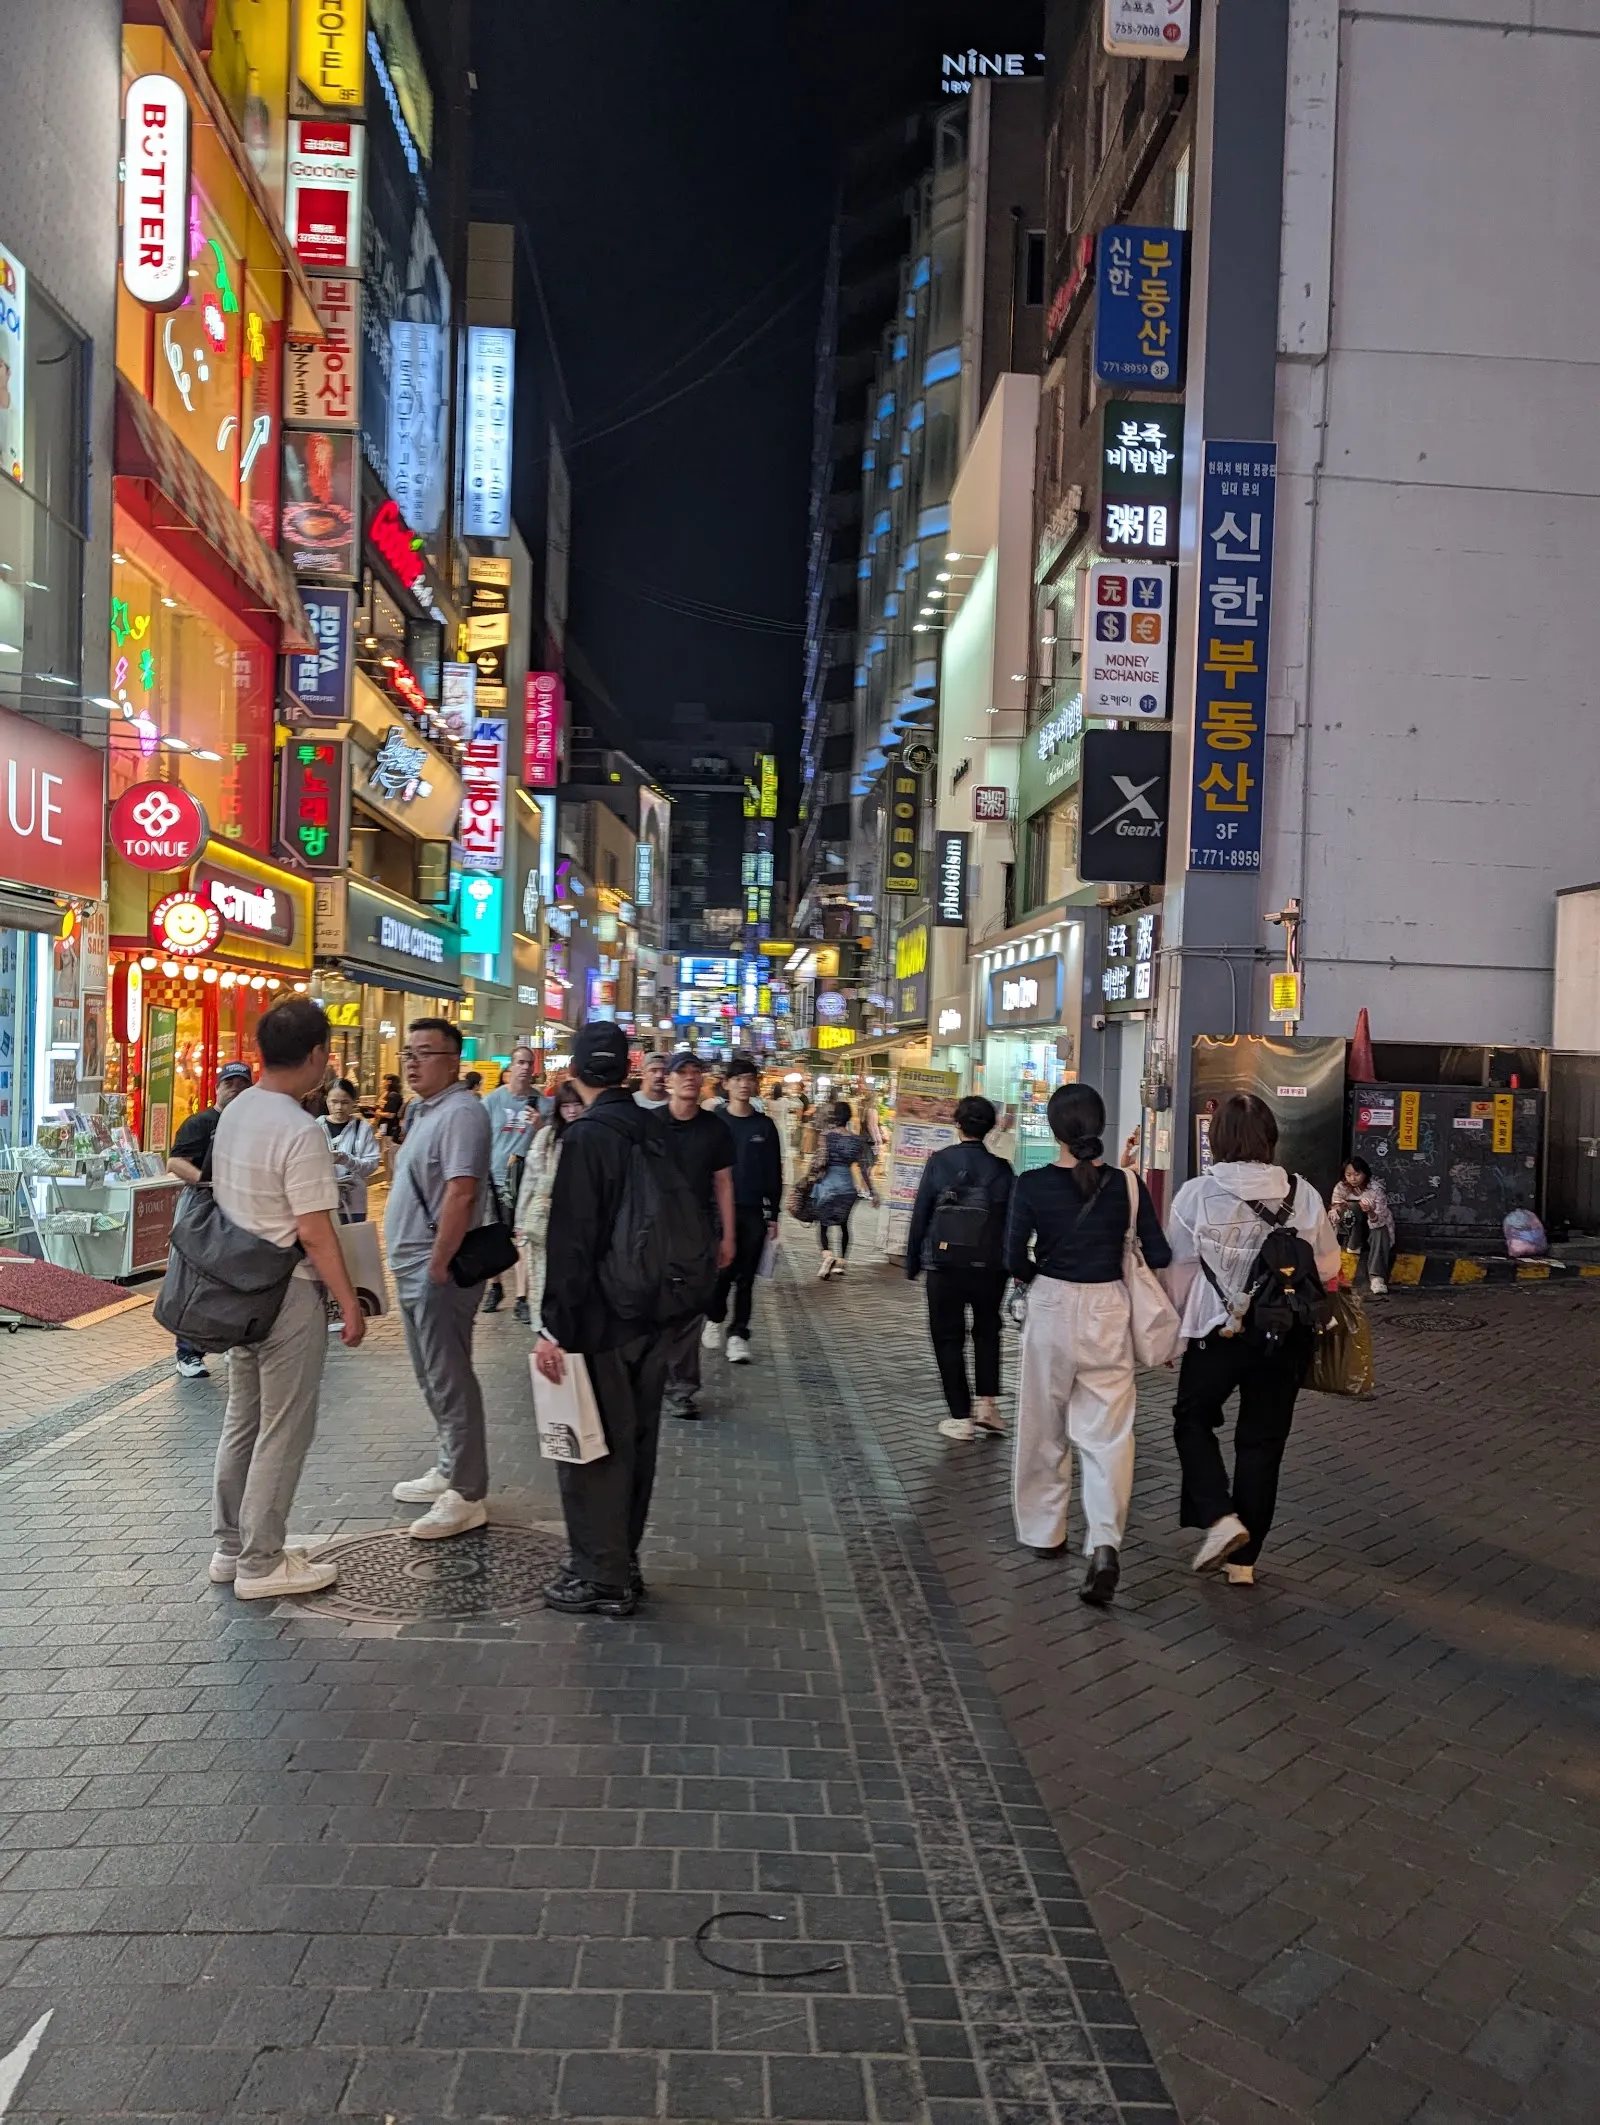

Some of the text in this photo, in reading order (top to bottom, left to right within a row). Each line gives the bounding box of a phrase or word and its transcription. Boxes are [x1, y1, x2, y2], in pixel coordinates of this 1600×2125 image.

[1115, 23, 1160, 37] 755-7008
[319, 0, 346, 88] HOTEL
[1109, 236, 1134, 297] 신한
[1137, 239, 1173, 357] 부동산
[316, 280, 353, 417] 부동산
[1103, 361, 1149, 375] 771-8959
[1153, 365, 1166, 376] 3F
[1116, 420, 1168, 450] 본죽
[1106, 446, 1176, 476] 비빔밥
[1221, 481, 1260, 497] 임대 문의
[1106, 503, 1145, 545] 粥
[319, 605, 341, 674] EDIYA
[1105, 653, 1150, 668] MONEY
[1093, 668, 1160, 684] EXCHANGE
[1098, 693, 1133, 707] 오케이
[536, 720, 553, 760] CLINIC
[299, 767, 330, 856] 노래방
[1116, 819, 1165, 838] GearX
[1216, 823, 1239, 840] 3F
[123, 839, 190, 858] TONUE
[1191, 848, 1260, 867] T.771-8959
[939, 838, 964, 921] photoism
[87, 912, 105, 936] BIG
[87, 936, 105, 956] SALE
[162, 937, 211, 955] BUTTER
[381, 916, 444, 963] EDIYA COFFEE
[1137, 967, 1150, 993] 2F
